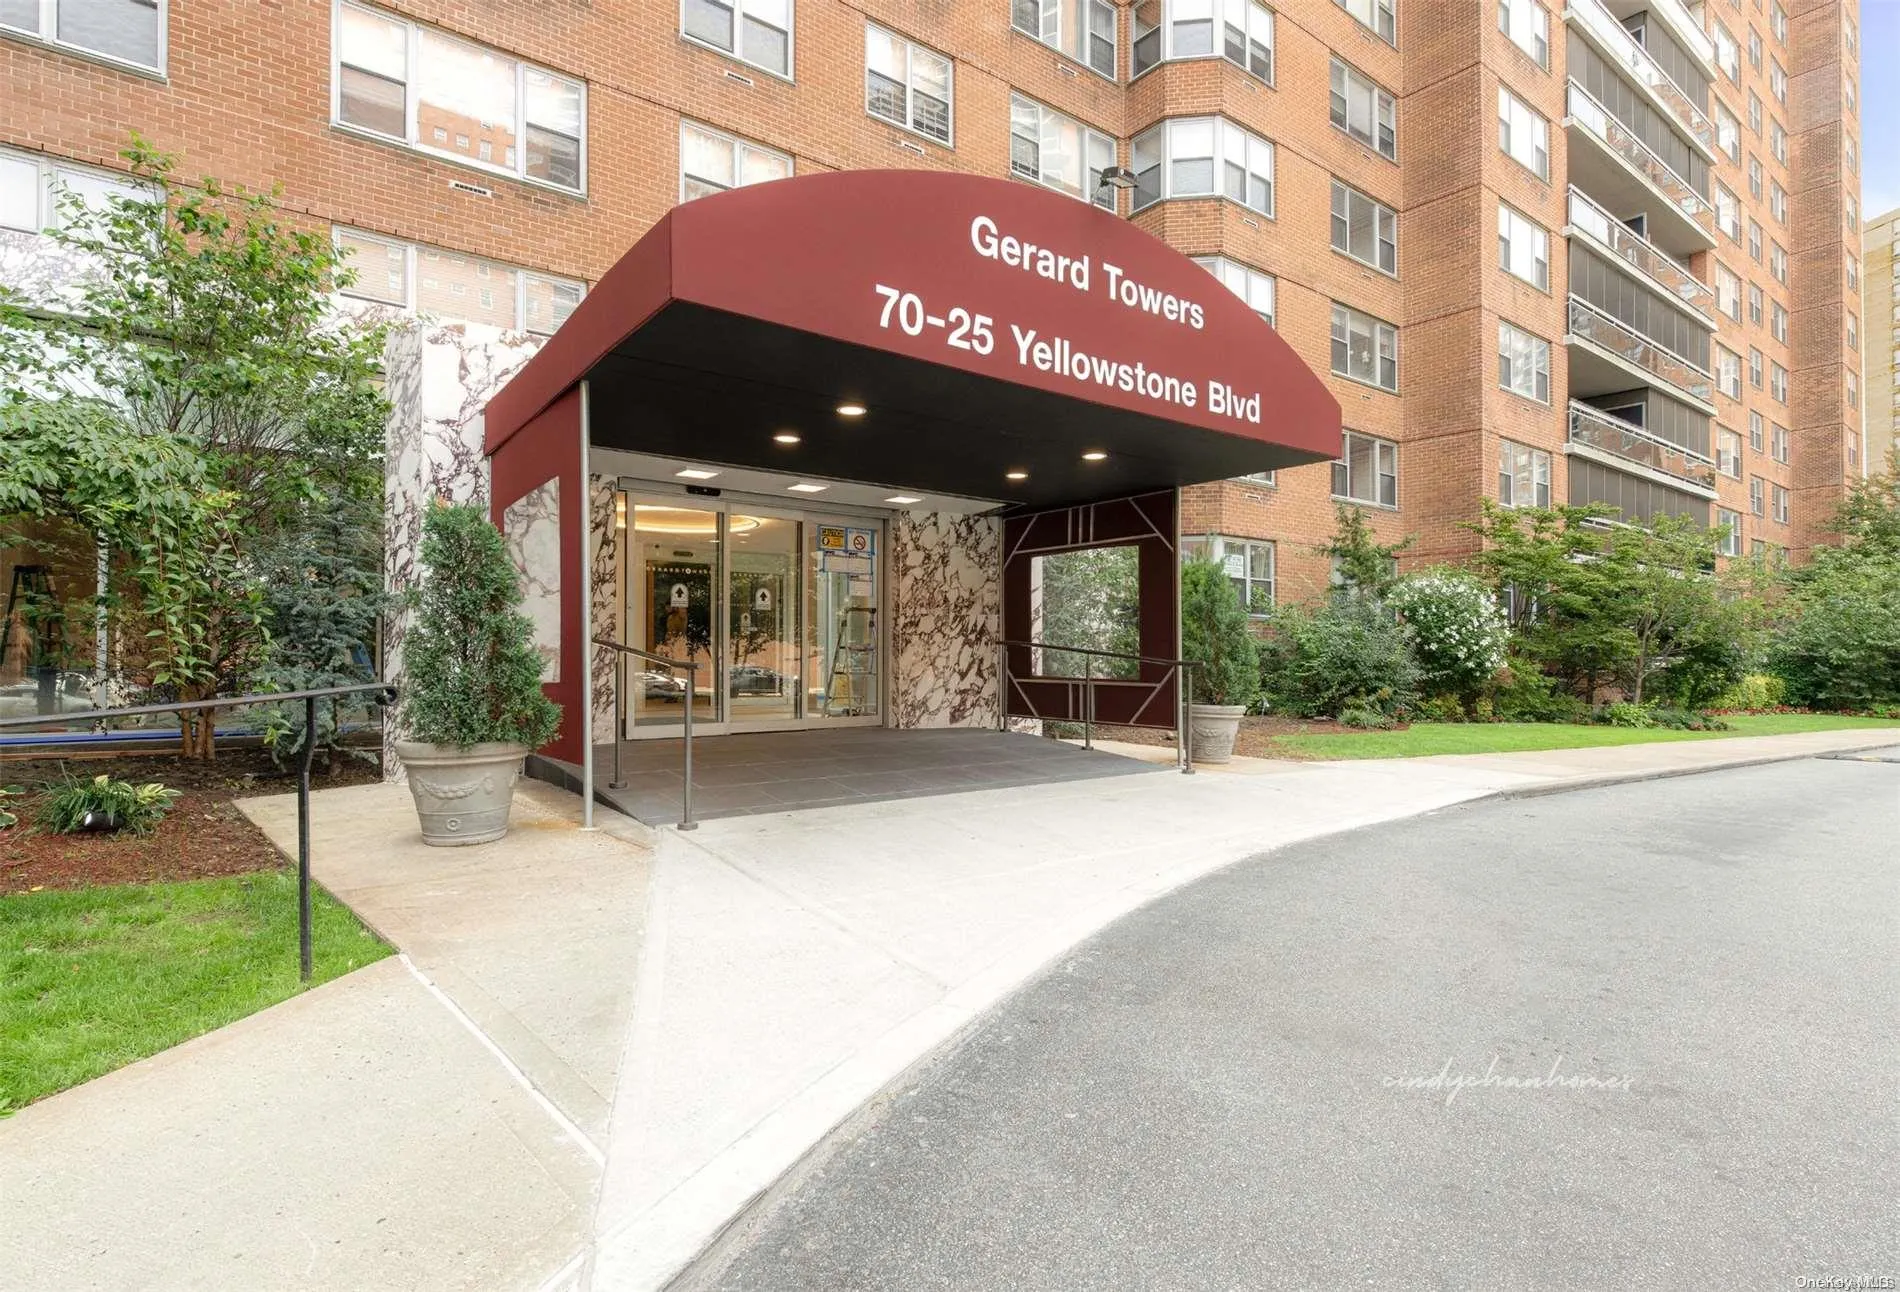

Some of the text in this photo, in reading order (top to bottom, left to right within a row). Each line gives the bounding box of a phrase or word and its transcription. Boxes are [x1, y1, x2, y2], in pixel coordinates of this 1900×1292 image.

[970, 215, 1205, 331] Gerard Towers
[875, 283, 1261, 424] 70-25 Yellowstone Blvd
